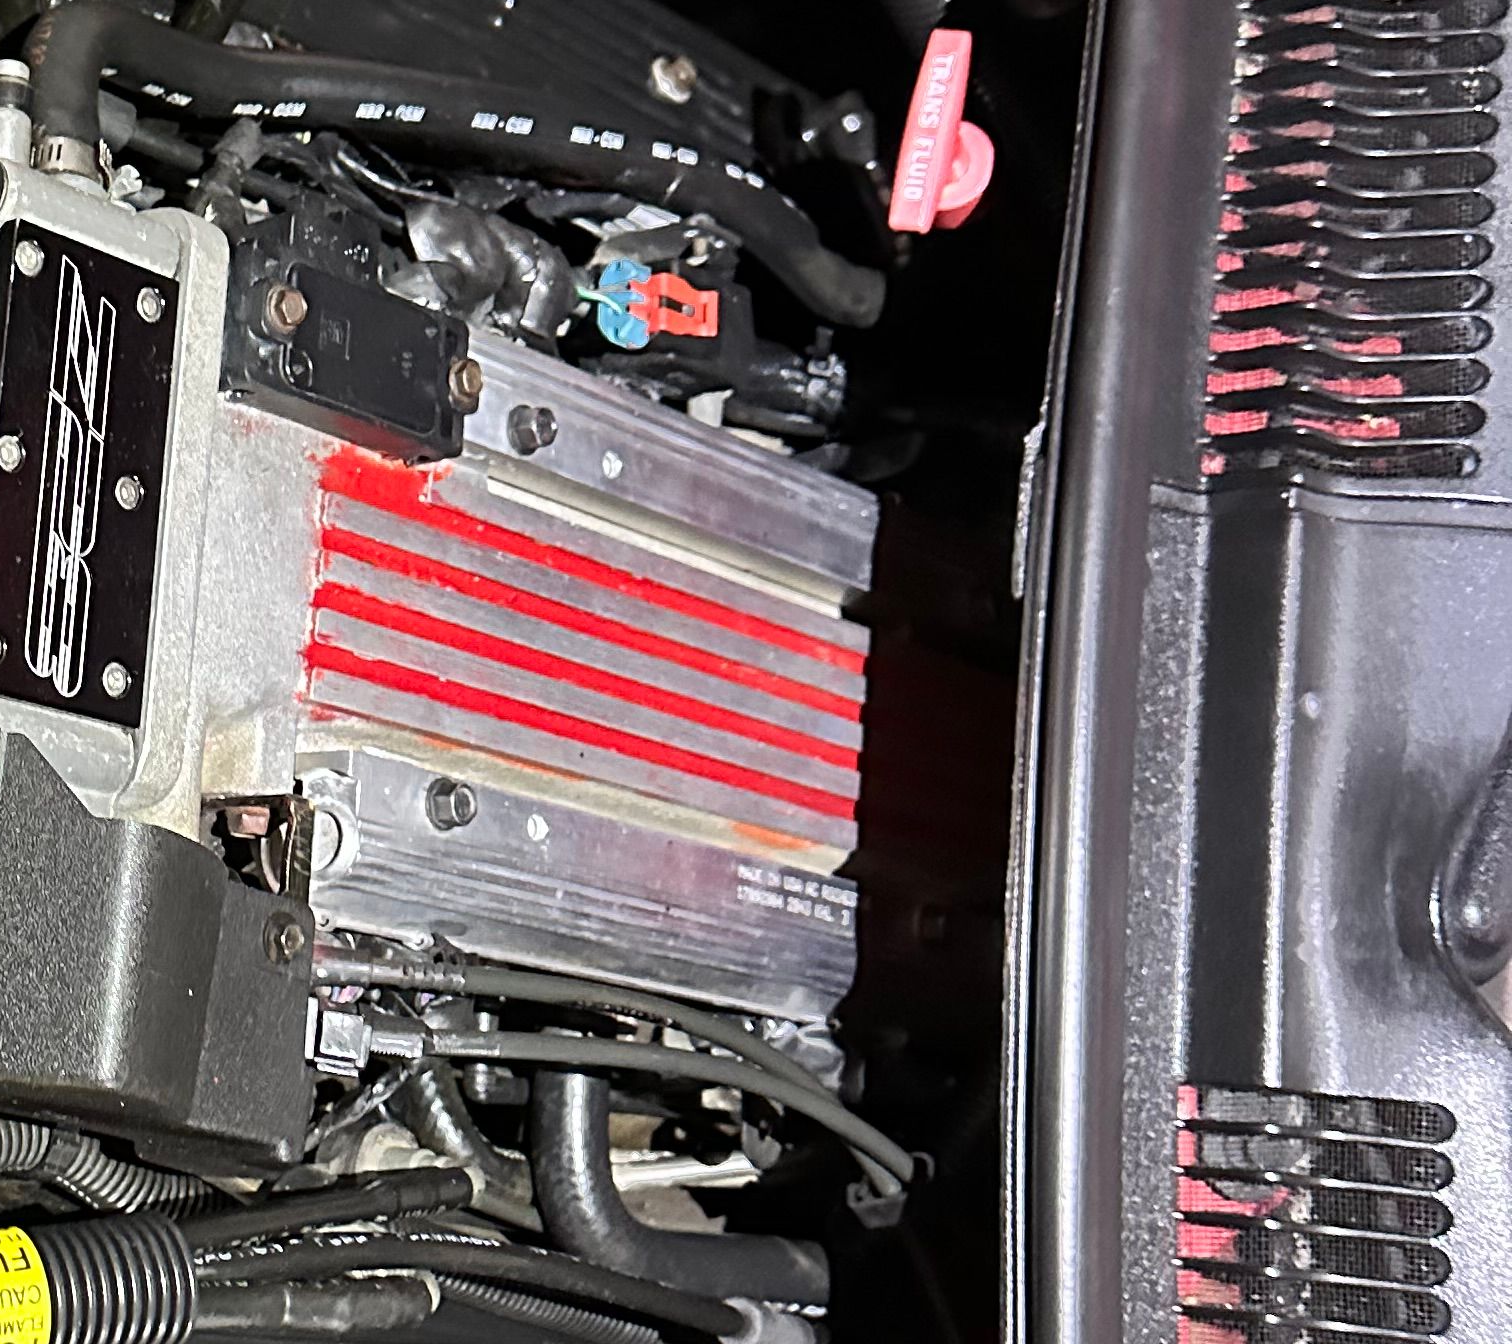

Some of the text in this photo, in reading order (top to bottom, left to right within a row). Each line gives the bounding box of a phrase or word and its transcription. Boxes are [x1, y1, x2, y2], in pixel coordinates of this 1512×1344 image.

[902, 53, 955, 203] TRANS FLUID
[23, 255, 116, 697] Z28
